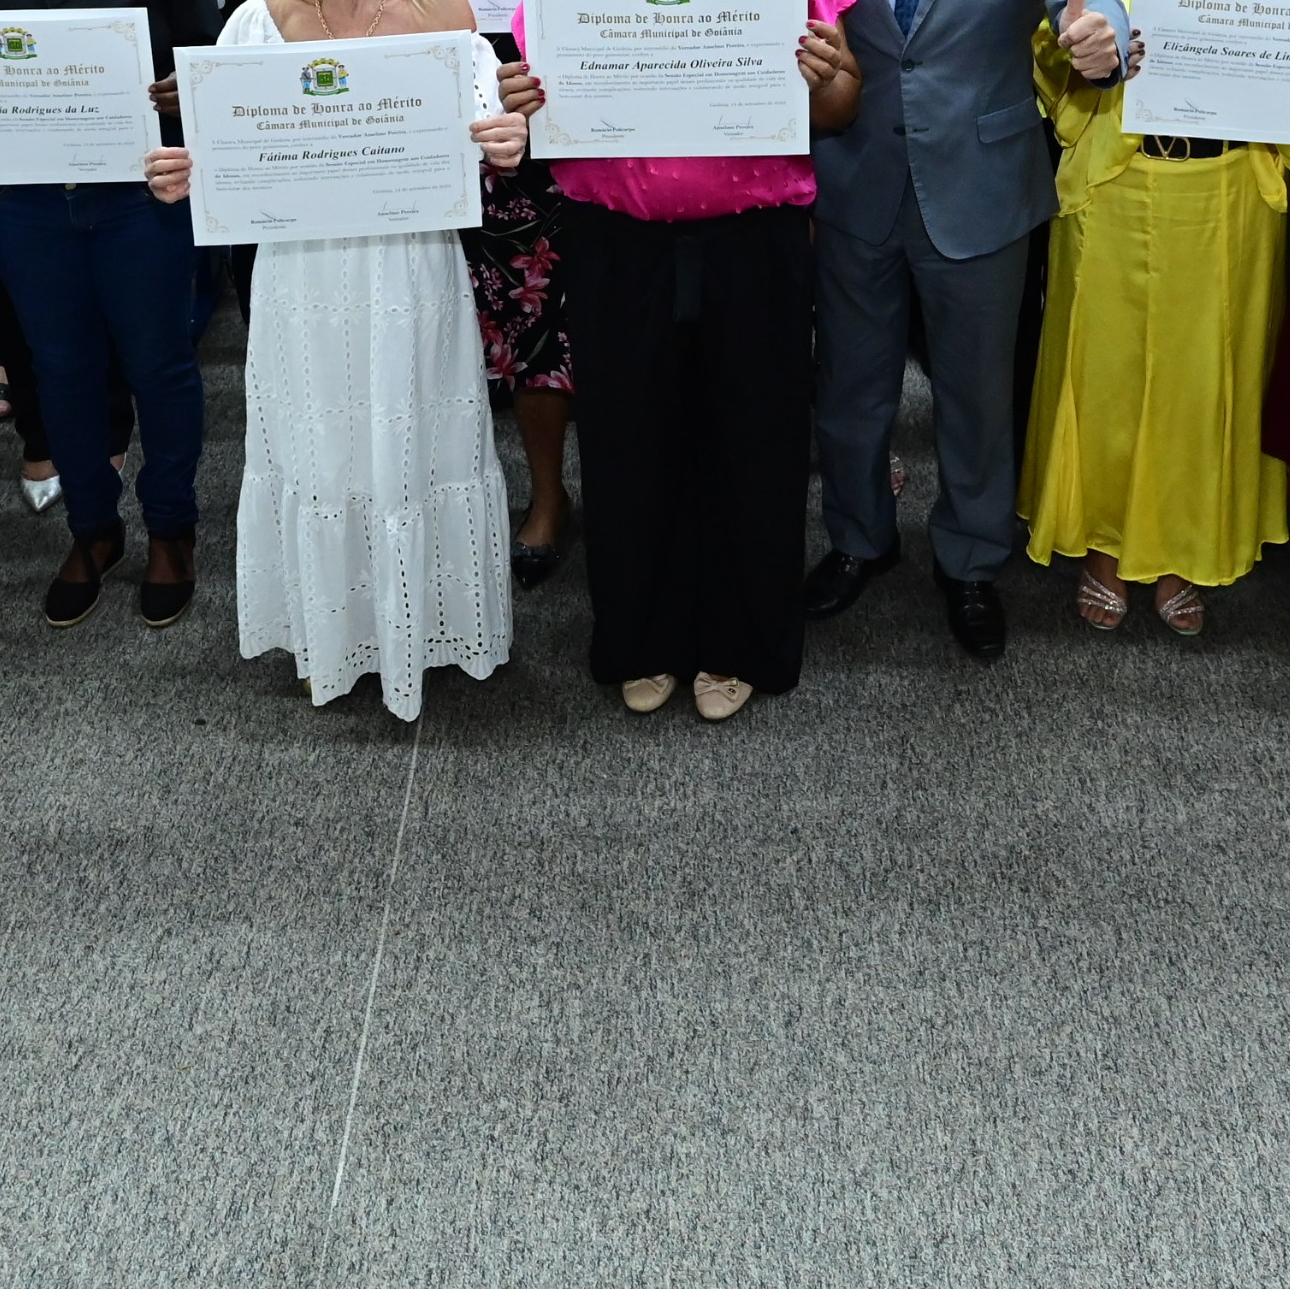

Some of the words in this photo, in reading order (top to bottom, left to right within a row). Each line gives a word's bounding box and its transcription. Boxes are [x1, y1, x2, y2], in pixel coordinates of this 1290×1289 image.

[1235, 2, 1247, 13] de
[577, 13, 631, 25] Diploma
[635, 14, 648, 23] de
[653, 13, 693, 25] Honra
[698, 15, 711, 23] ao
[716, 10, 759, 23] Mérito
[600, 29, 637, 38] Câmara
[640, 29, 688, 38] Municipal
[705, 28, 742, 37] Goiânia
[1163, 42, 1217, 55] Elizângela
[1220, 47, 1256, 57] Soares
[1259, 51, 1271, 59] de
[4, 66, 42, 75] Honra
[63, 64, 104, 75] Mérito
[580, 61, 629, 70] Ednamar
[632, 60, 686, 71] Aparecida
[690, 60, 732, 68] Oliveira
[736, 57, 762, 66] Silva
[11, 106, 61, 115] Rodrigues
[232, 106, 288, 118] Diploma
[292, 105, 306, 114] de
[311, 103, 353, 114] Honra
[358, 103, 372, 111] ao
[377, 98, 421, 110] Mérito
[256, 121, 295, 130] Câmara
[299, 118, 348, 129] Municipal
[365, 114, 404, 124] Goiânia
[259, 153, 298, 162] Fátima
[302, 150, 357, 159] Rodrigues
[361, 147, 404, 155] Caitano
